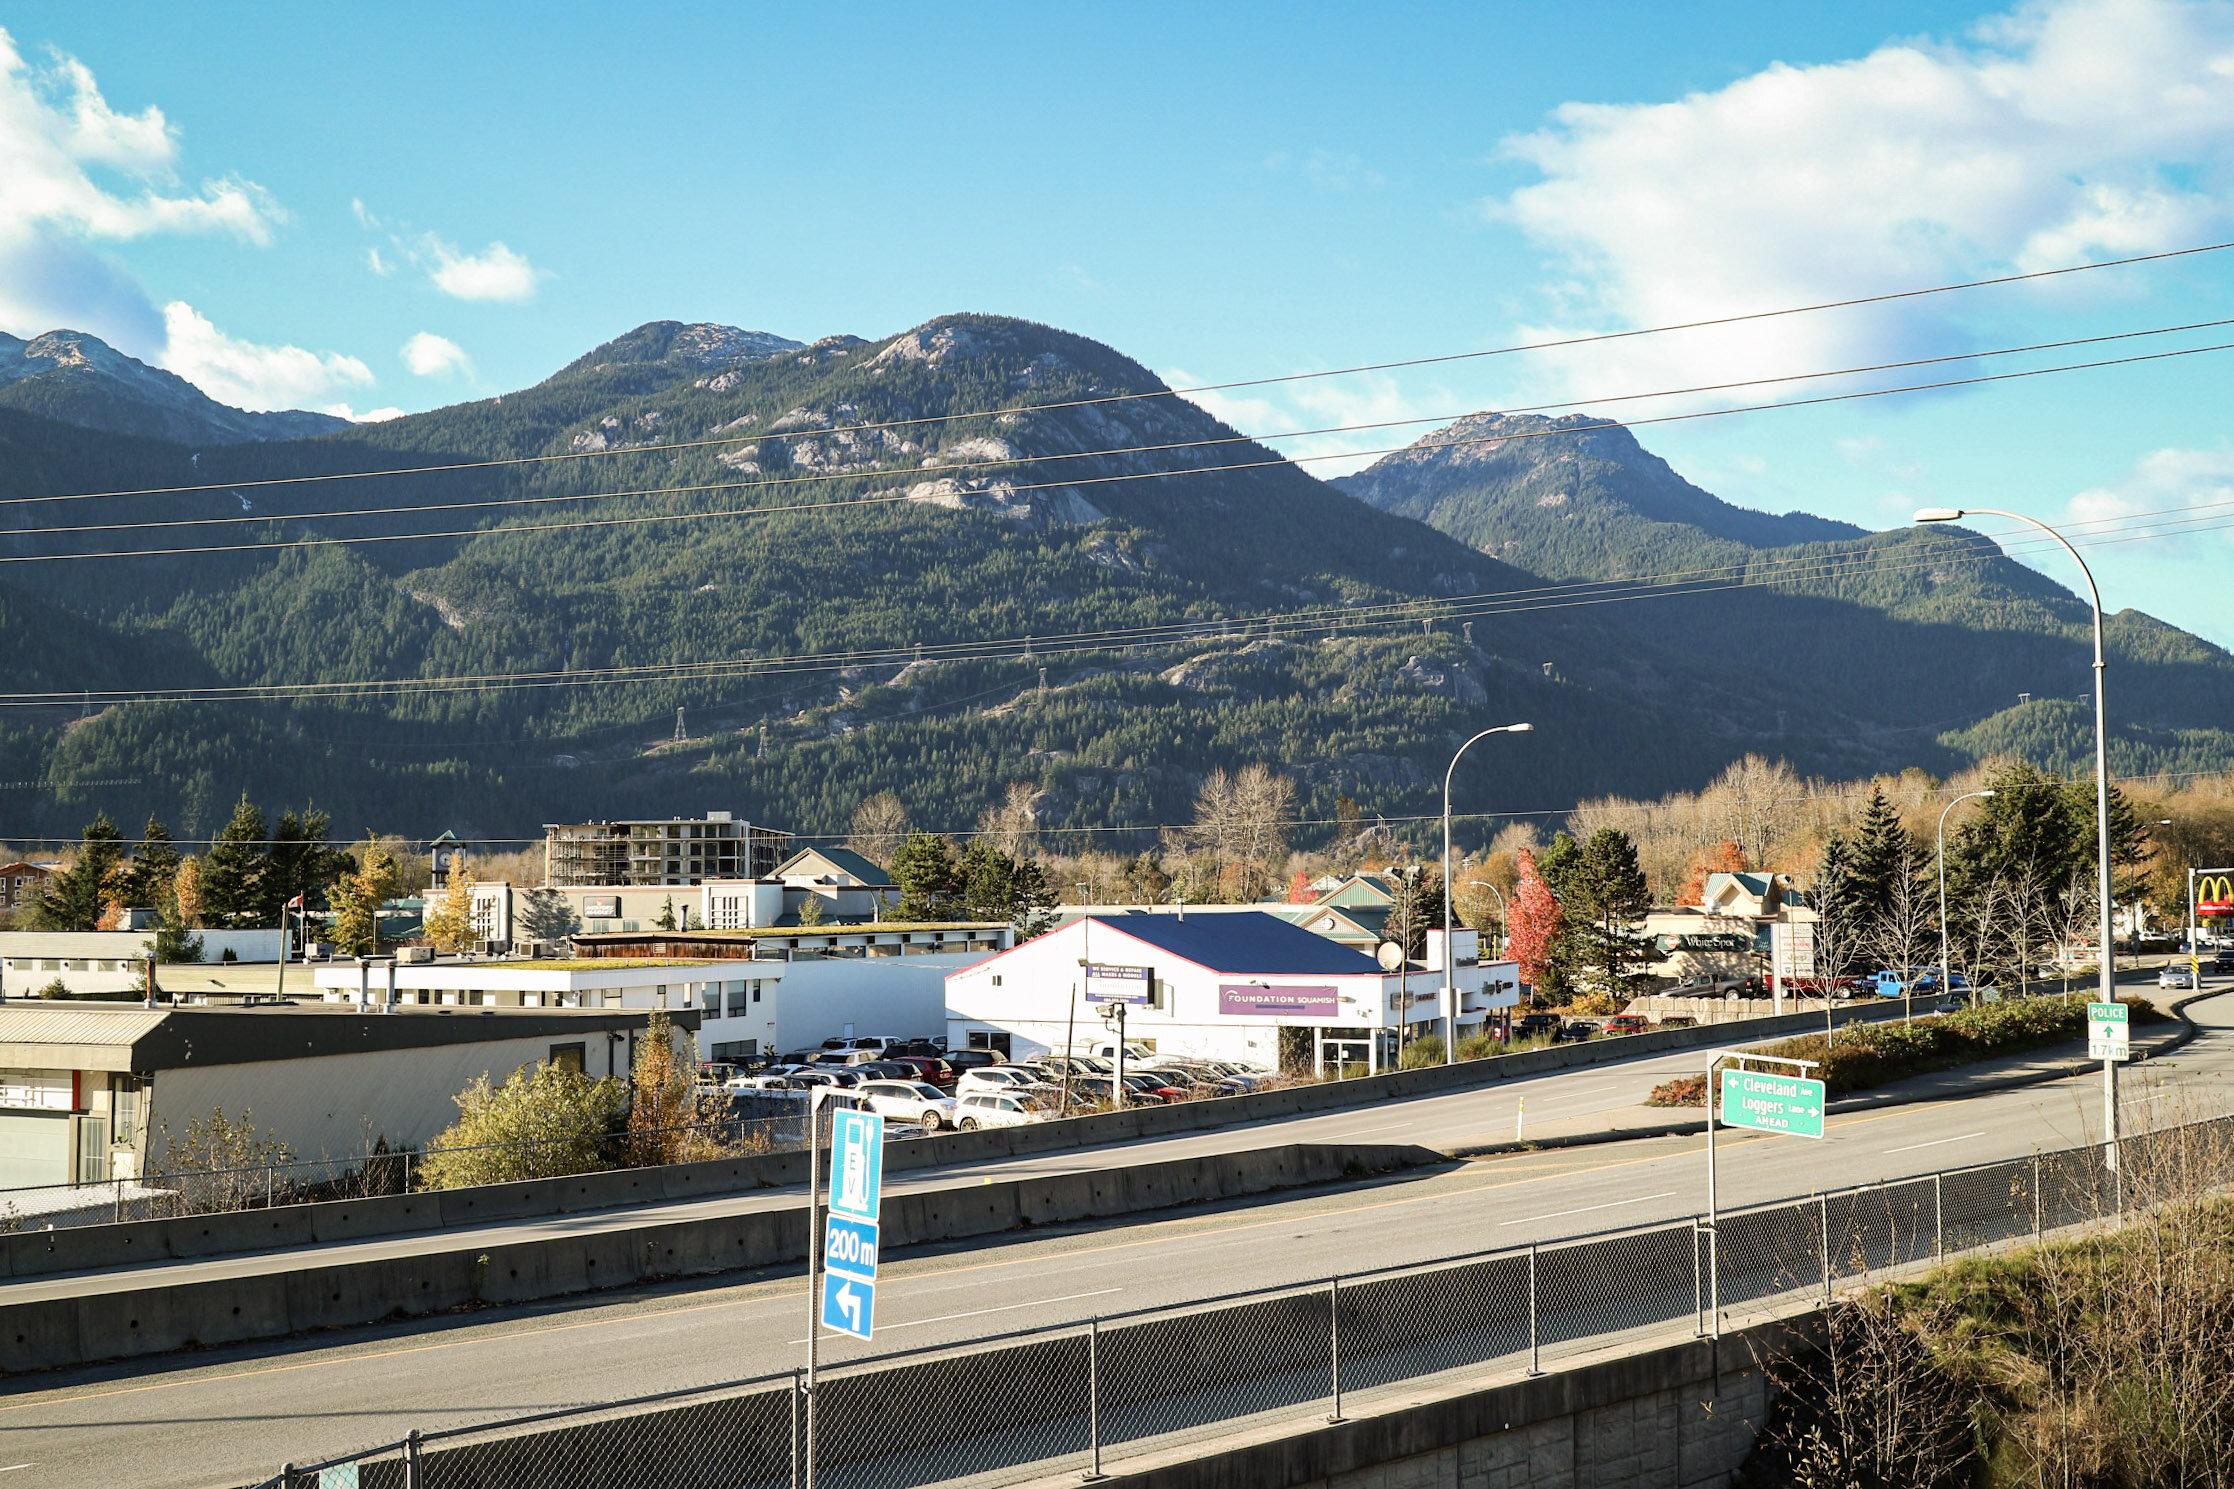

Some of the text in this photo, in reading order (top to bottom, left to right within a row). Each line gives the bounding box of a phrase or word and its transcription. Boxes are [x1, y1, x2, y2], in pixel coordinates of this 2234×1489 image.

[1685, 935, 1712, 947] White
[1712, 936, 1735, 949] Spot
[1228, 995, 1336, 1004] FOUNDATION SQUAMISH
[2091, 1007, 2125, 1018] POLICE
[1744, 1077, 1813, 1097] Cleveland Ave
[1742, 1095, 1805, 1115] Loggers Lane
[1755, 1115, 1789, 1128] AHEAD
